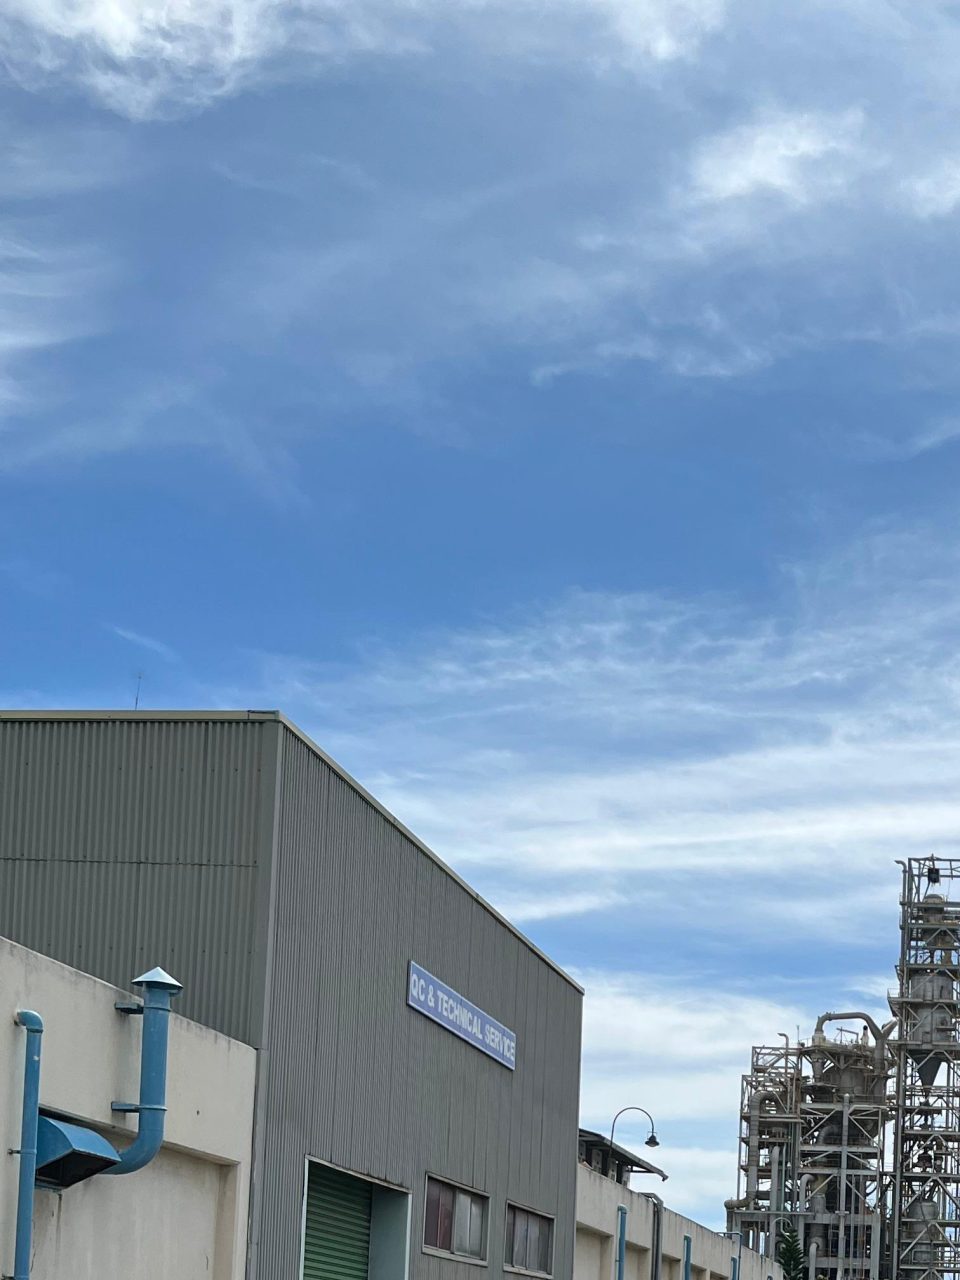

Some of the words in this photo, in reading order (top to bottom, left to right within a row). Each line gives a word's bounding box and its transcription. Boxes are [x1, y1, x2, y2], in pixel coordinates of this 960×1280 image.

[412, 973, 426, 1002] QC
[428, 984, 435, 1008] &
[437, 990, 483, 1040] TECHNICAL
[485, 1024, 516, 1060] SERVICE
